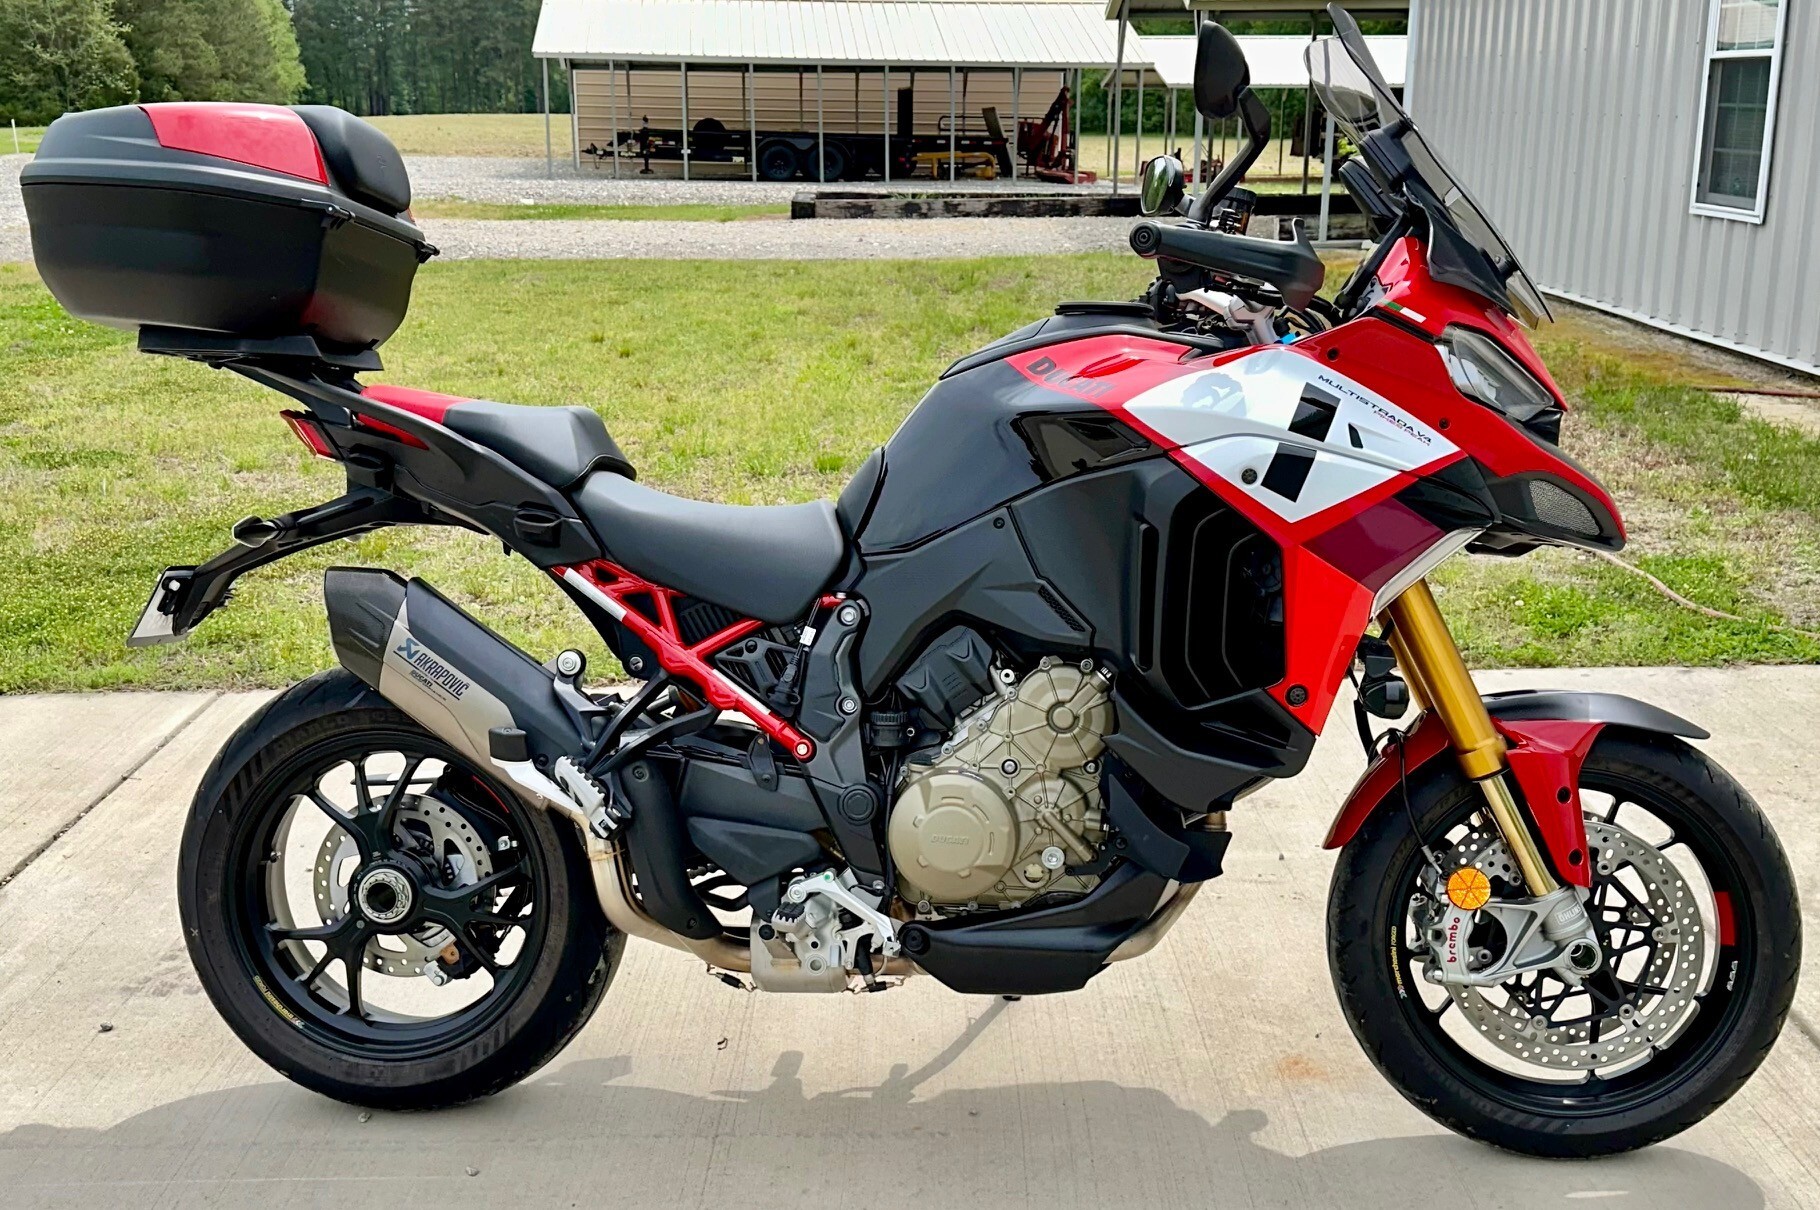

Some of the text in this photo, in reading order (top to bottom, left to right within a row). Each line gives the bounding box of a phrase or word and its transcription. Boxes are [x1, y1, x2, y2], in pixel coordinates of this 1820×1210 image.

[1318, 374, 1414, 432] MULTISTRADA
[930, 834, 969, 845] DUCATI
[1447, 917, 1461, 963] brembo
